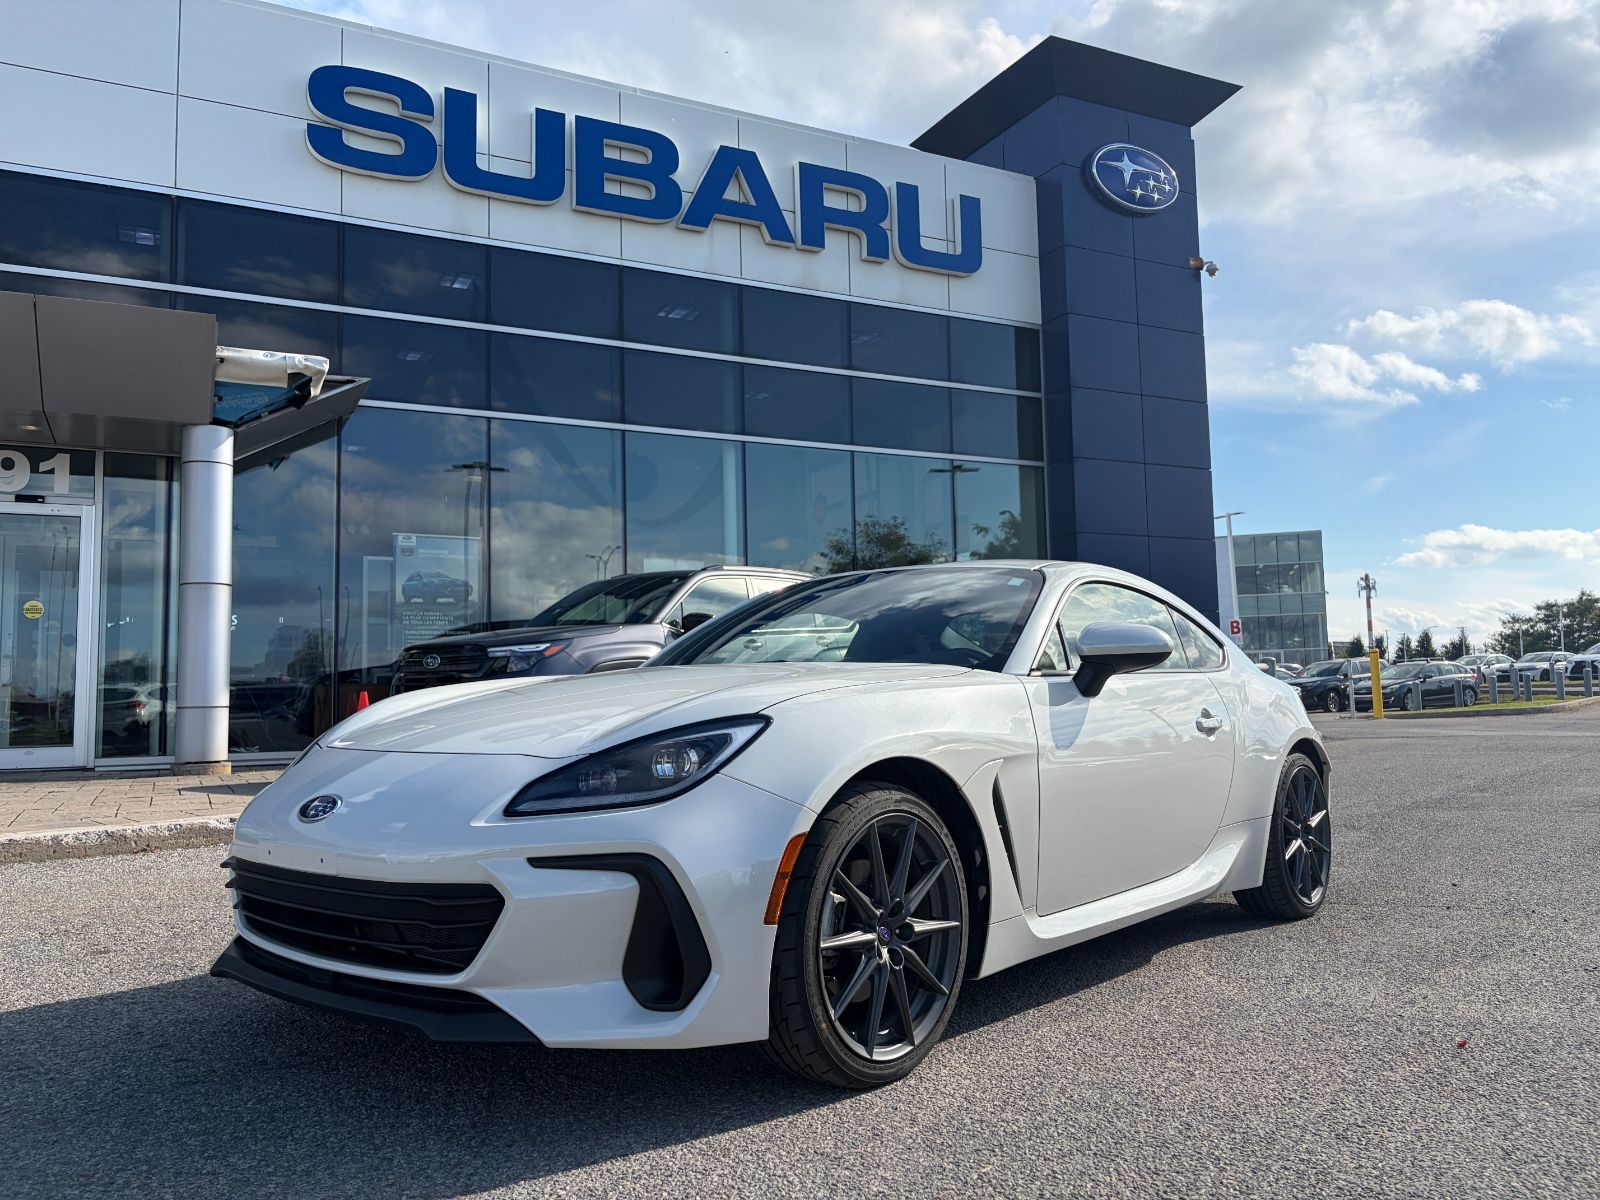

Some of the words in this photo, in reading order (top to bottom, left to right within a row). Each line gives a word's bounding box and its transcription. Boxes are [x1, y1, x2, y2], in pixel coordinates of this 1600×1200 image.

[306, 64, 983, 277] SUBARU
[0, 449, 71, 495] 91
[1230, 620, 1241, 635] B
